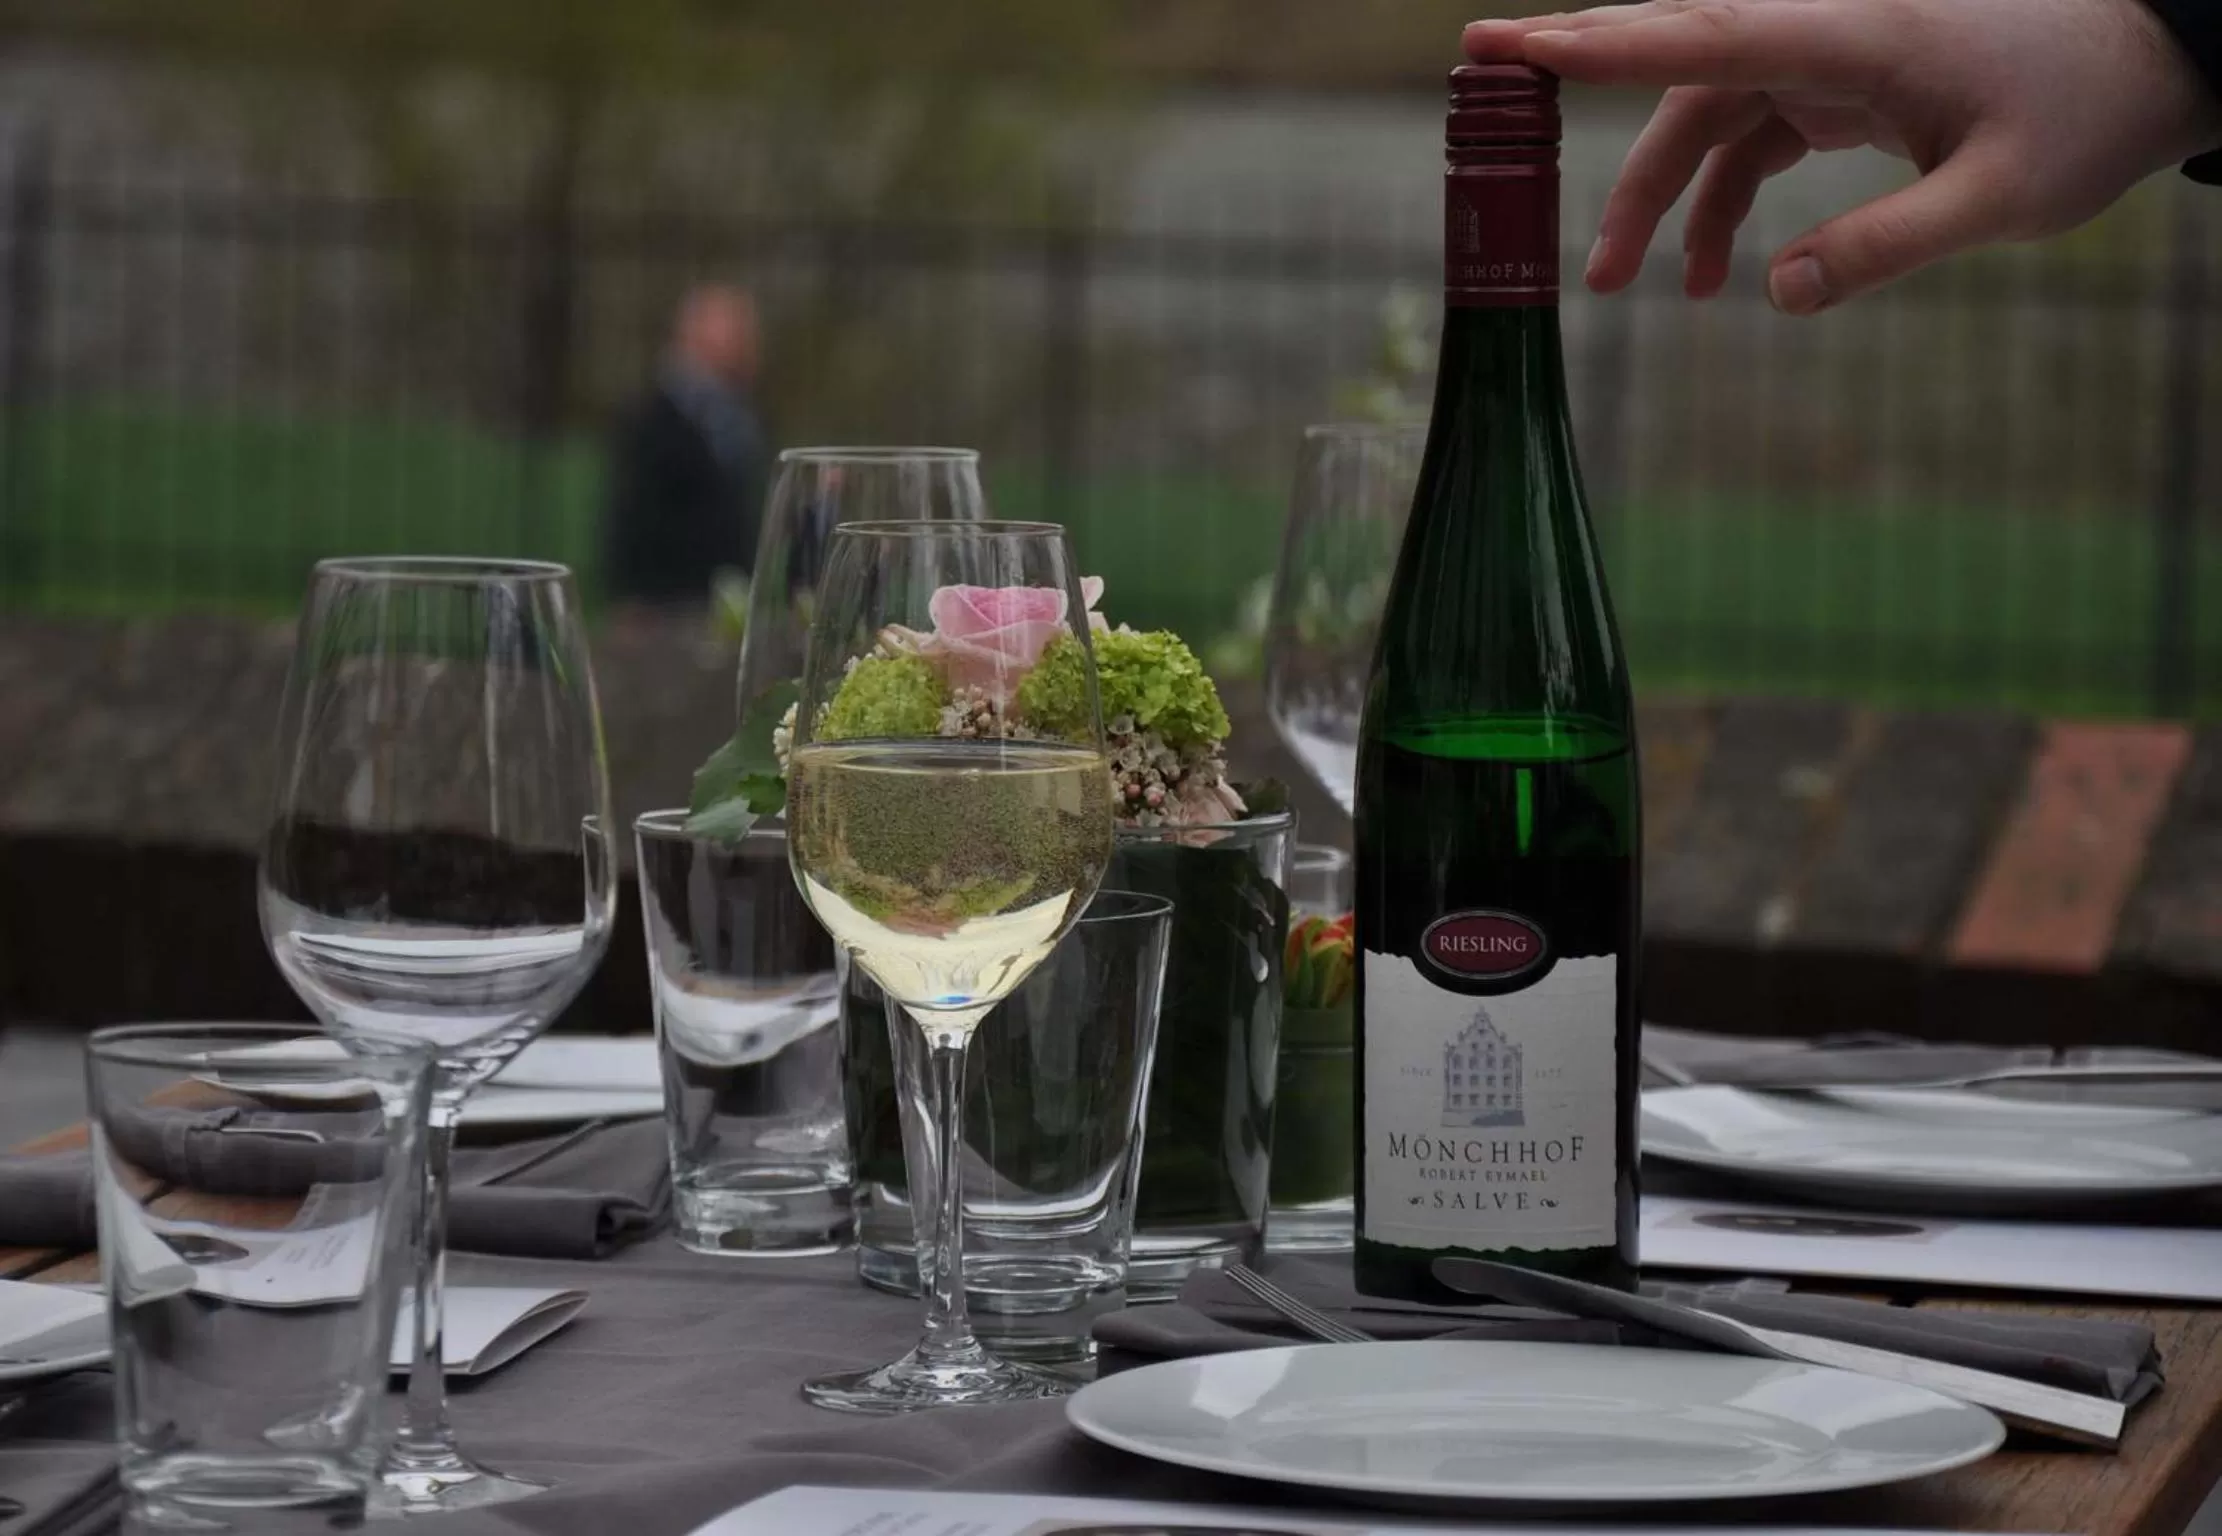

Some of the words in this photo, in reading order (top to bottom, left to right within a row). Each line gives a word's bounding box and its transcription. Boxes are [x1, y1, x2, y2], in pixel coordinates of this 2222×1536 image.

[1439, 935, 1528, 953] RIESLING
[1388, 1131, 1585, 1164] MÖNCHHOF
[1418, 1167, 1477, 1182] ROBERT
[1432, 1190, 1531, 1211] SALVE
